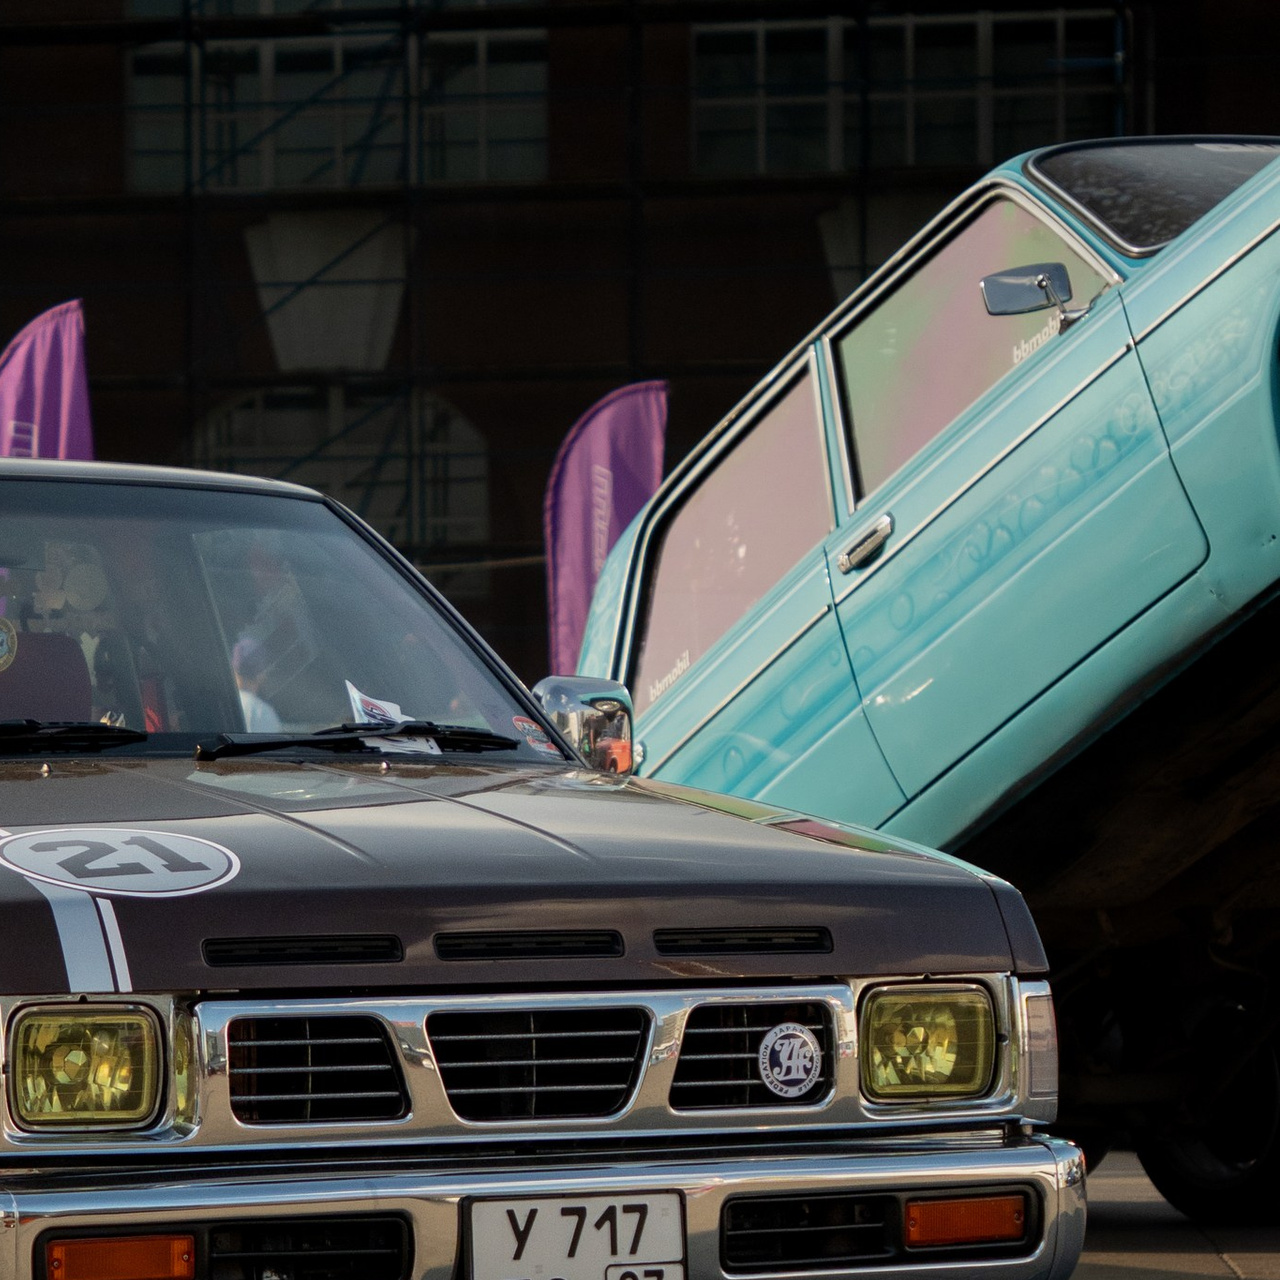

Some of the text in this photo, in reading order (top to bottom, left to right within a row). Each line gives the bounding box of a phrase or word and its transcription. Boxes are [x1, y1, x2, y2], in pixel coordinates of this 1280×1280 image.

[1013, 309, 1061, 363] bbmobi
[29, 835, 212, 879] 21
[773, 1025, 805, 1037] JAPAN
[761, 1044, 790, 1094] FEDERATION
[560, 1203, 648, 1257] 717
